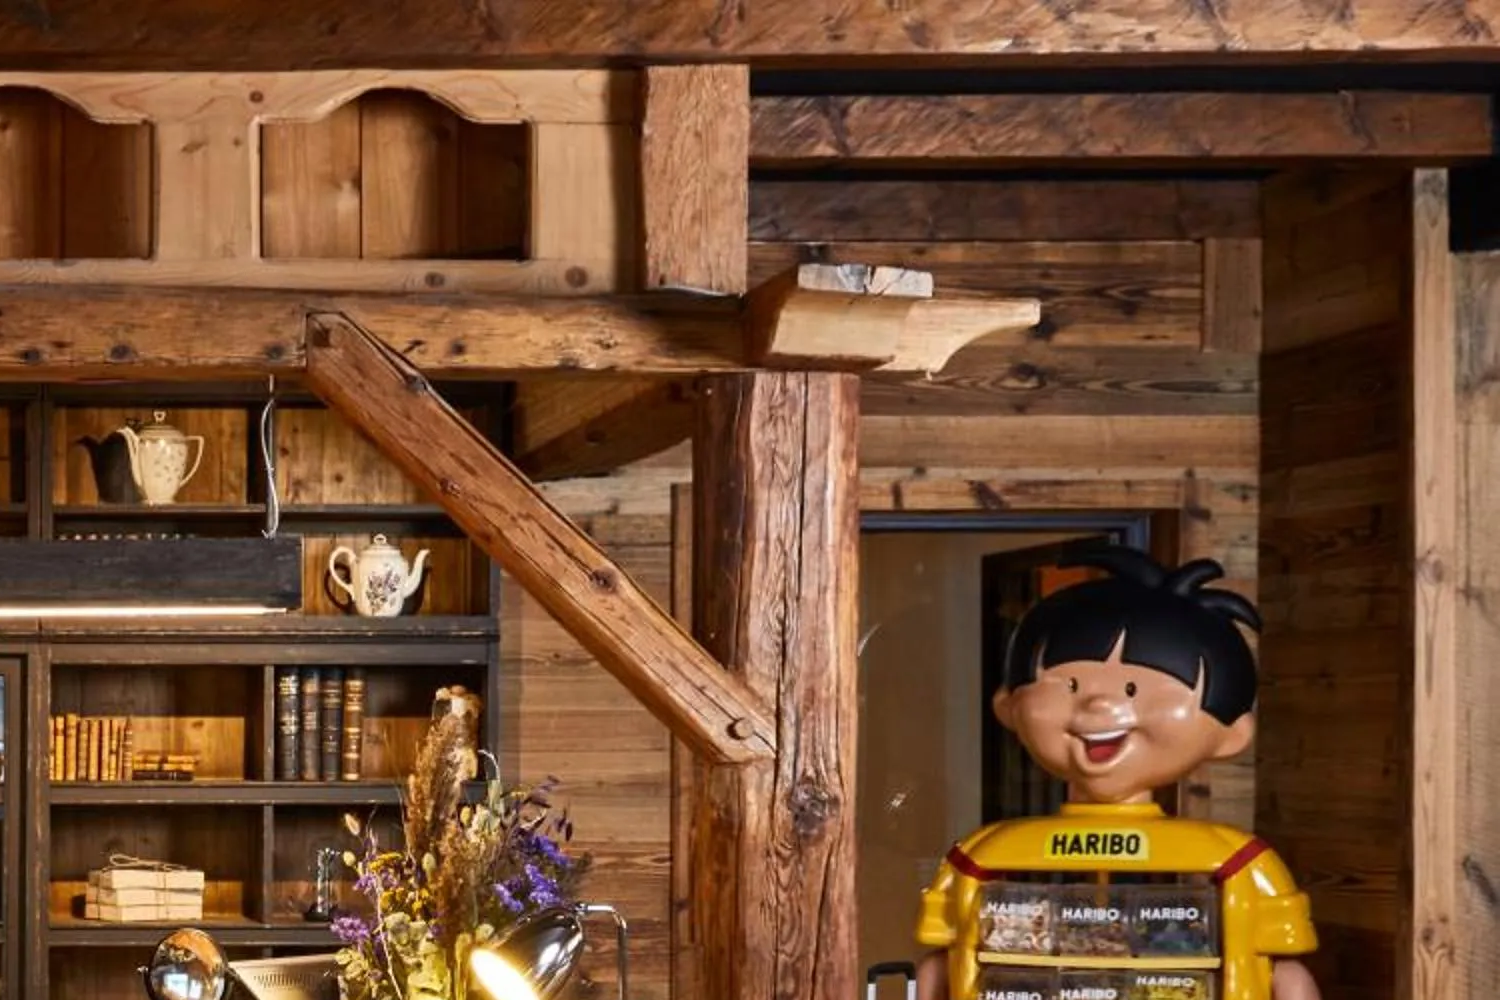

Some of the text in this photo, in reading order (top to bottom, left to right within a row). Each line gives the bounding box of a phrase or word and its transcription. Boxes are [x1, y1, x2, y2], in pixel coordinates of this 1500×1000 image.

[1051, 833, 1141, 855] HARIBO
[987, 902, 1043, 916] HARIBO
[1062, 907, 1120, 921] HARIBO
[1139, 907, 1199, 920] HARIBO
[1135, 976, 1196, 987] HARIBO
[1059, 988, 1117, 1000] HARIBO
